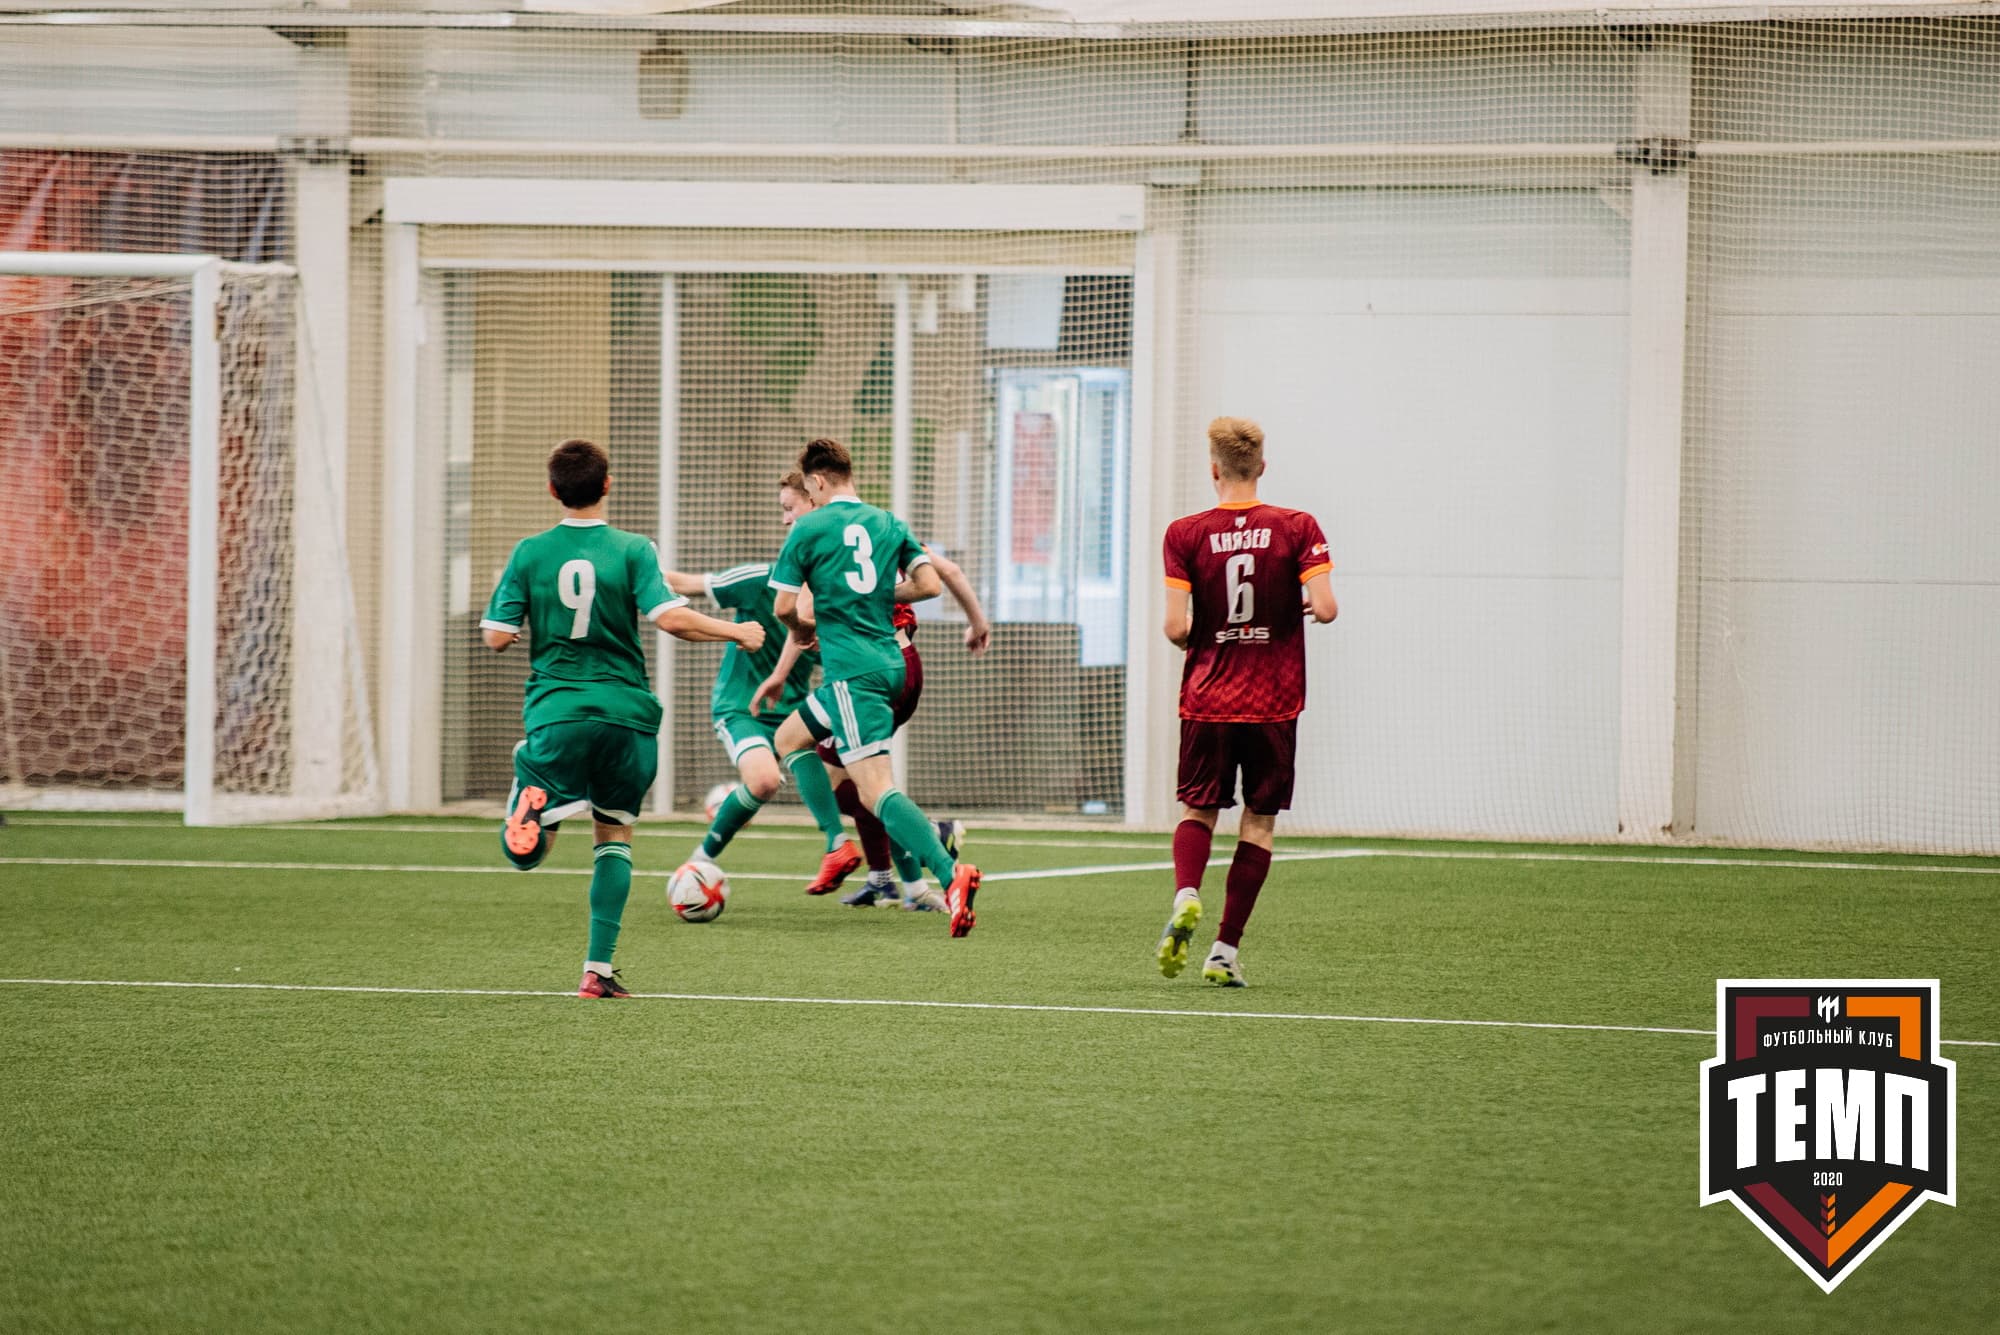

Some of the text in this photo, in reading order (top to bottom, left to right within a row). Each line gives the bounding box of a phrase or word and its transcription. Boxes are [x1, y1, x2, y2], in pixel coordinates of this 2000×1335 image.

[843, 523, 878, 595] 3
[1209, 528, 1272, 554] КНЯЗЕВ
[557, 559, 597, 640] 9
[1226, 553, 1255, 623] 6
[1215, 627, 1270, 643] SEUS
